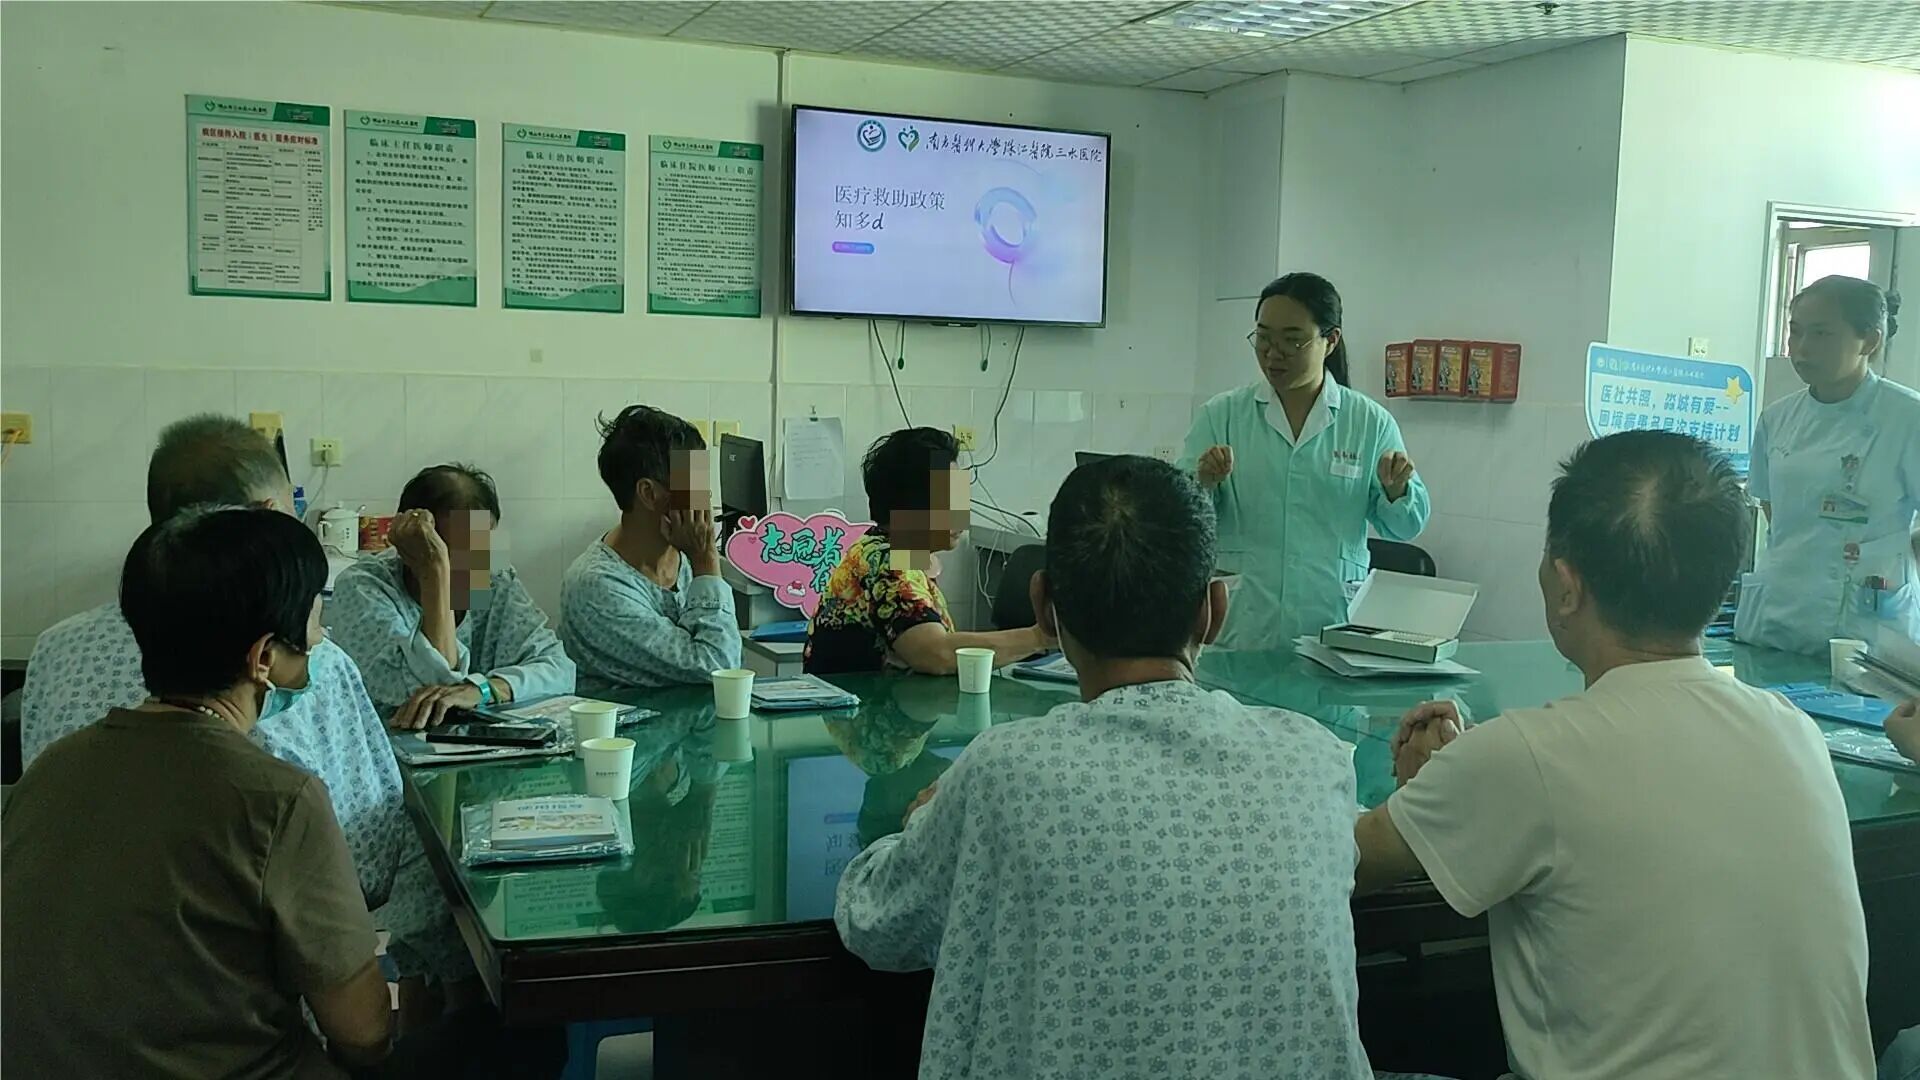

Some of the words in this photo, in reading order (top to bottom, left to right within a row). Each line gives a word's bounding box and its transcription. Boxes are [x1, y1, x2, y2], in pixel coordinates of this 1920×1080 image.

[835, 184, 945, 210] 医疗救助政策
[835, 210, 884, 230] 知多d
[759, 522, 845, 567] 志愿者
